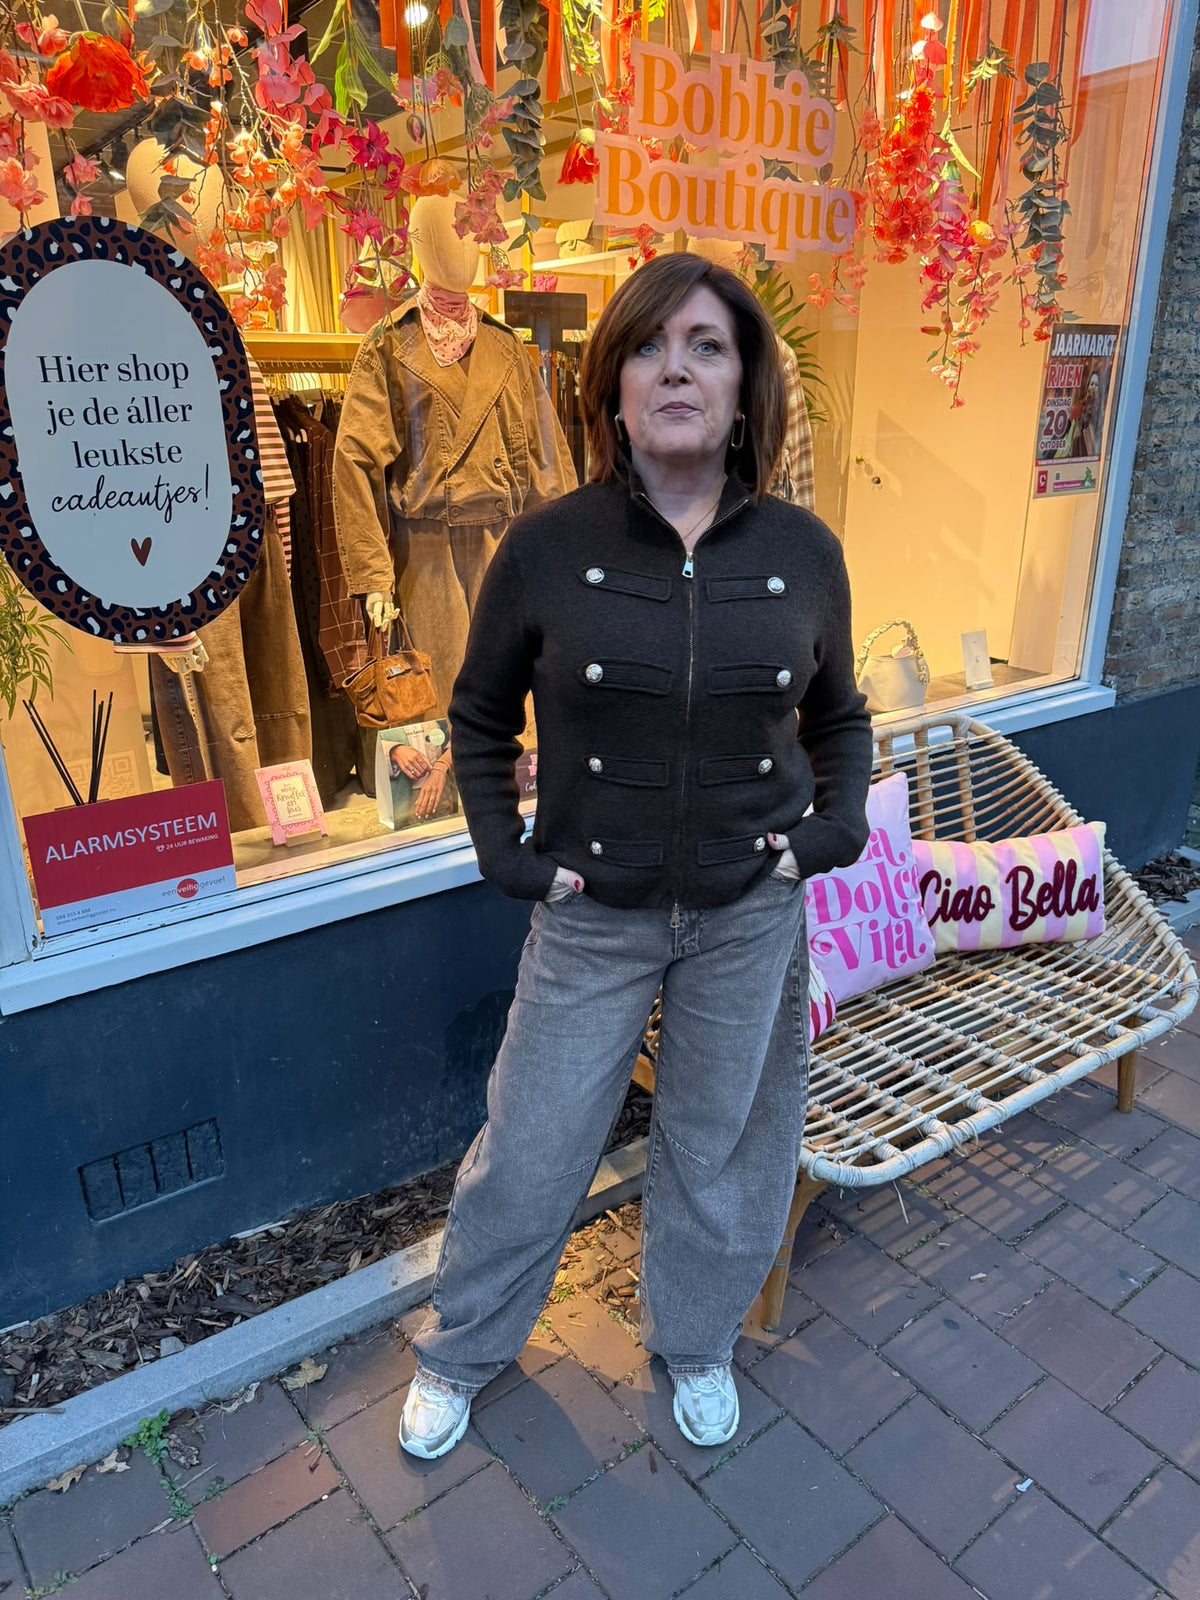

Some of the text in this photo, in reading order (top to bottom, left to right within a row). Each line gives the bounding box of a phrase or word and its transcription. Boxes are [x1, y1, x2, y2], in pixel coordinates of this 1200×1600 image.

[637, 53, 829, 157] Bobbie
[603, 145, 849, 251] Boutique
[1051, 333, 1117, 357] JAARMARKT
[37, 353, 190, 389] Hier shop
[1046, 364, 1084, 388] RIJEN
[46, 396, 192, 435] je de áller
[1046, 398, 1072, 407] DINSDAG
[1043, 409, 1068, 436] 20
[72, 439, 183, 468] leukste
[1039, 440, 1067, 450] OKTOBER
[51, 463, 210, 523] cadeautjes!
[45, 811, 218, 864] ALARMSYSTEEM
[174, 840, 188, 848] UUR
[188, 833, 219, 845] BEWAKING
[854, 827, 906, 867] a
[162, 876, 226, 897] een veilig gevoel
[920, 858, 1100, 932] Ciao Bella
